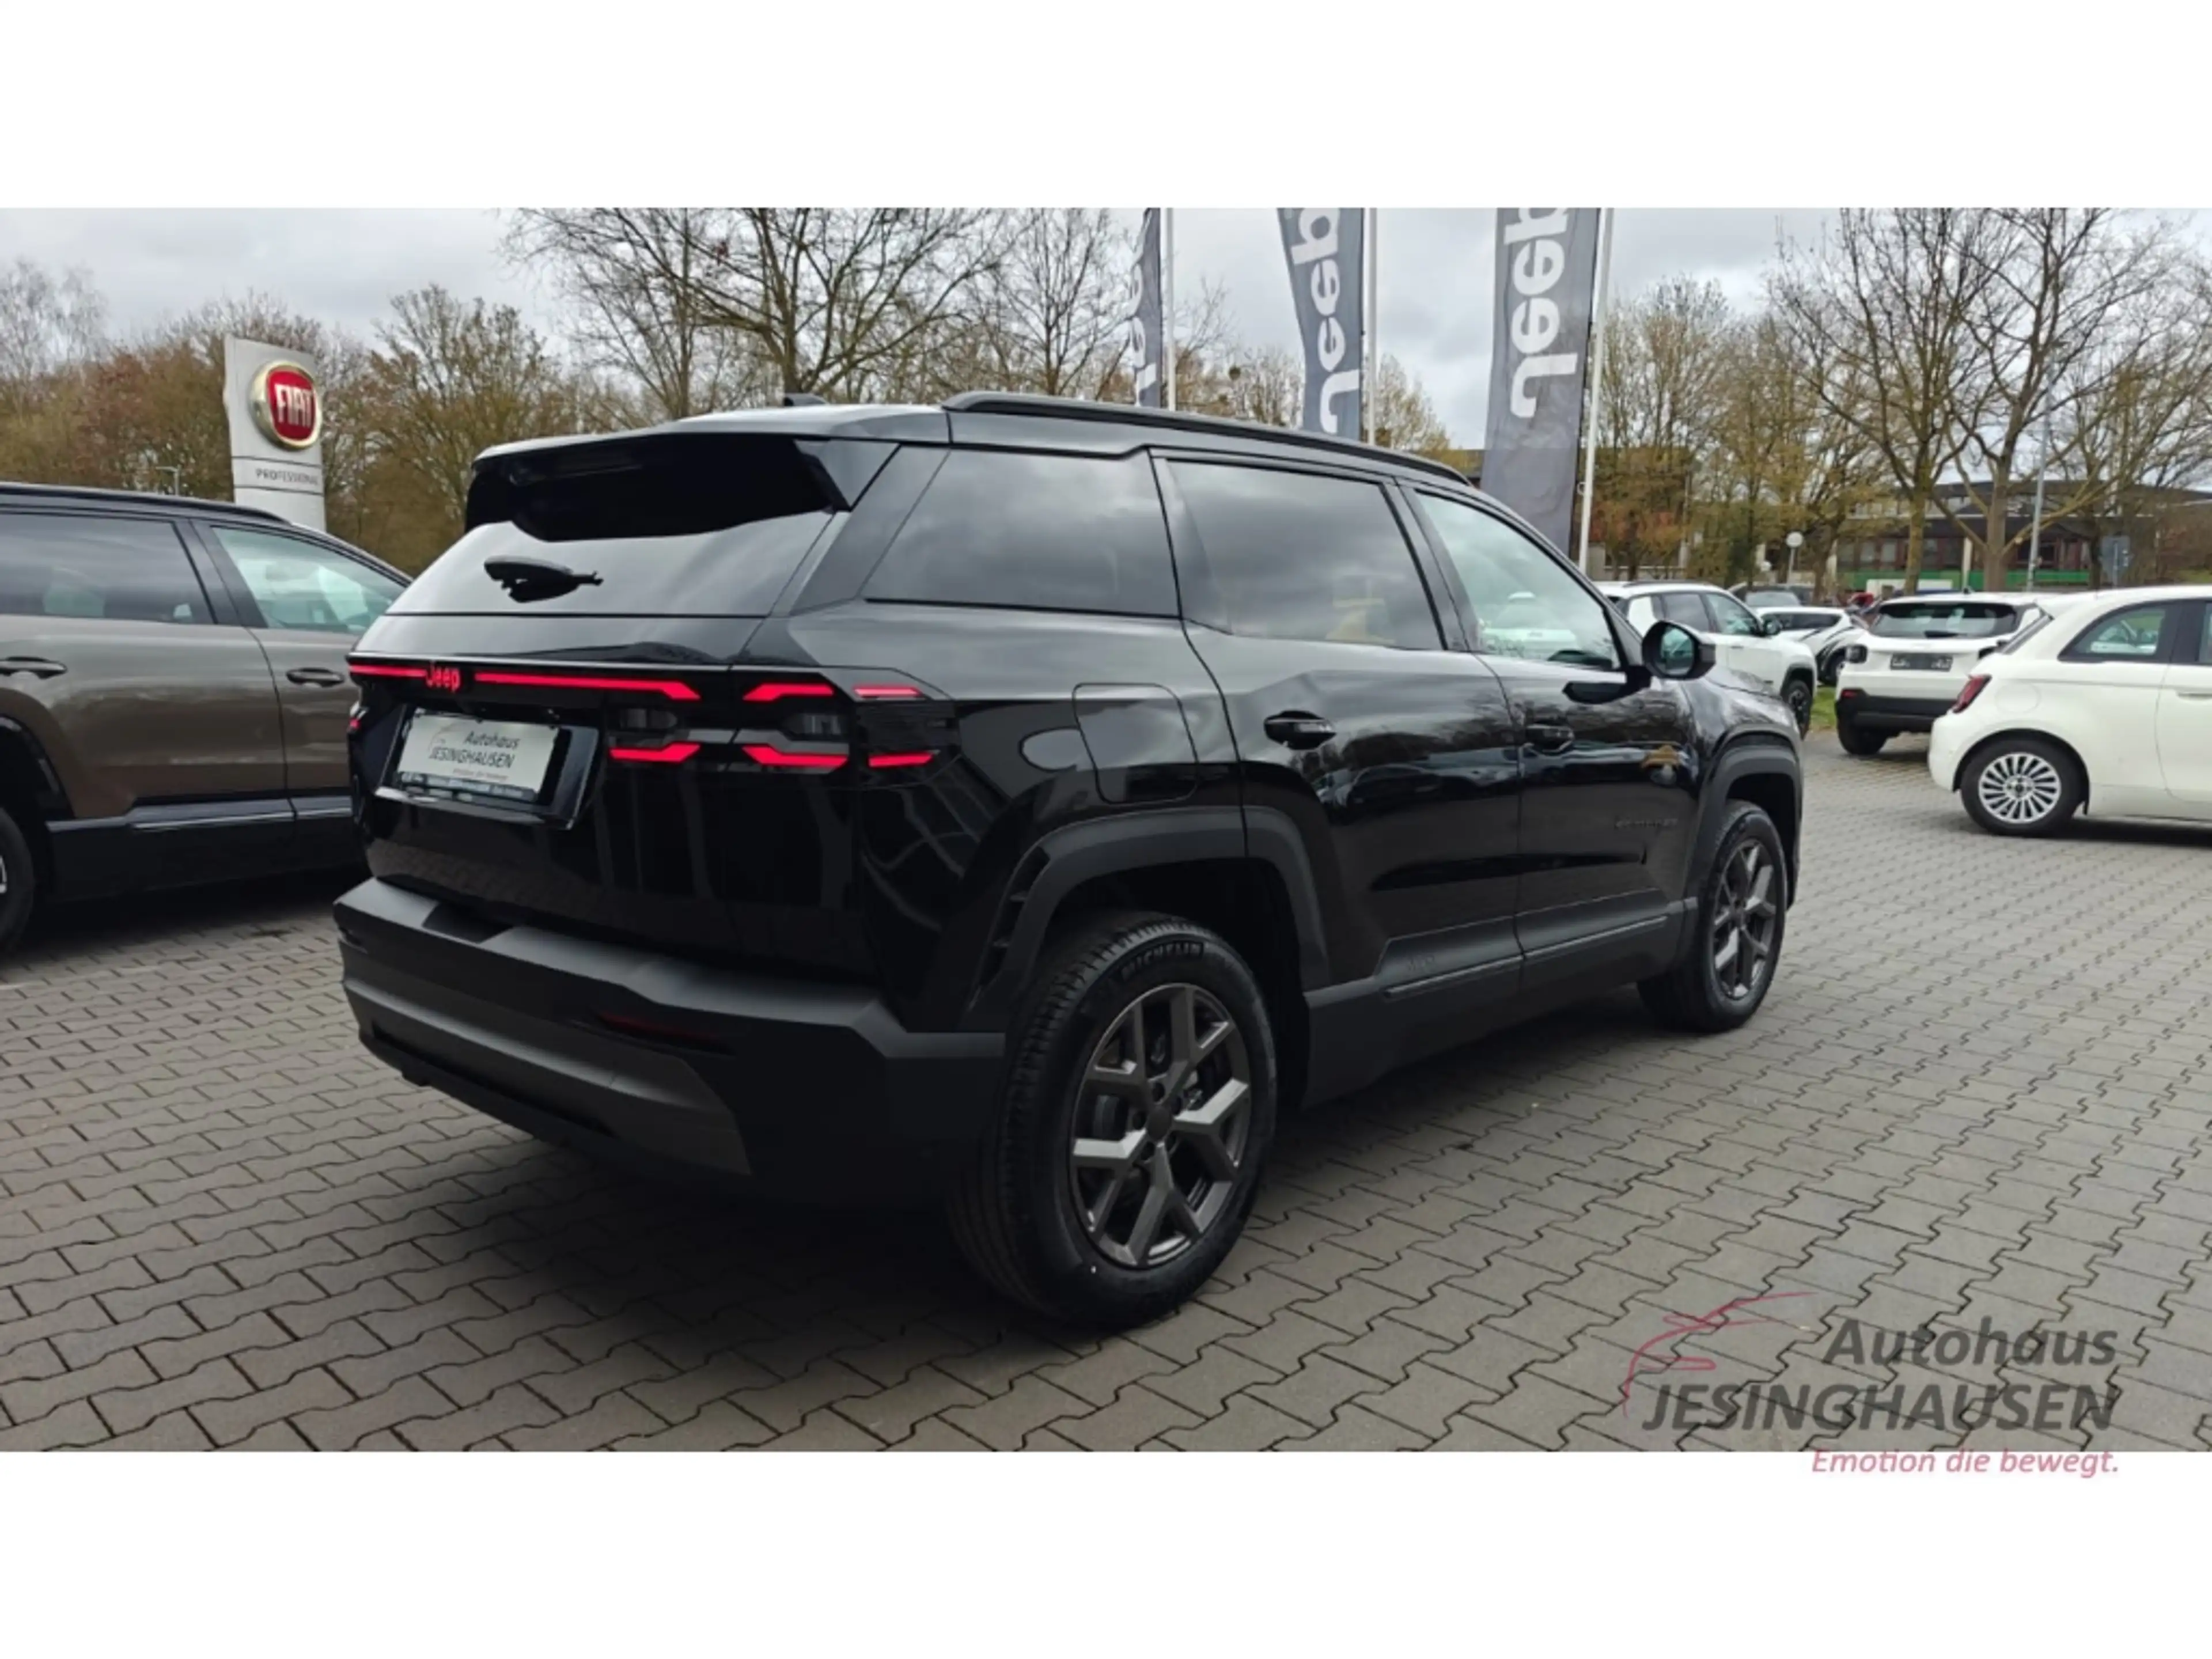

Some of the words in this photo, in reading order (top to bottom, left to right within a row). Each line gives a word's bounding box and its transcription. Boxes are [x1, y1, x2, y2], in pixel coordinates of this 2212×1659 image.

[274, 383, 313, 427] FIAT
[426, 662, 460, 693] Jeep
[463, 730, 520, 749] Autohaus
